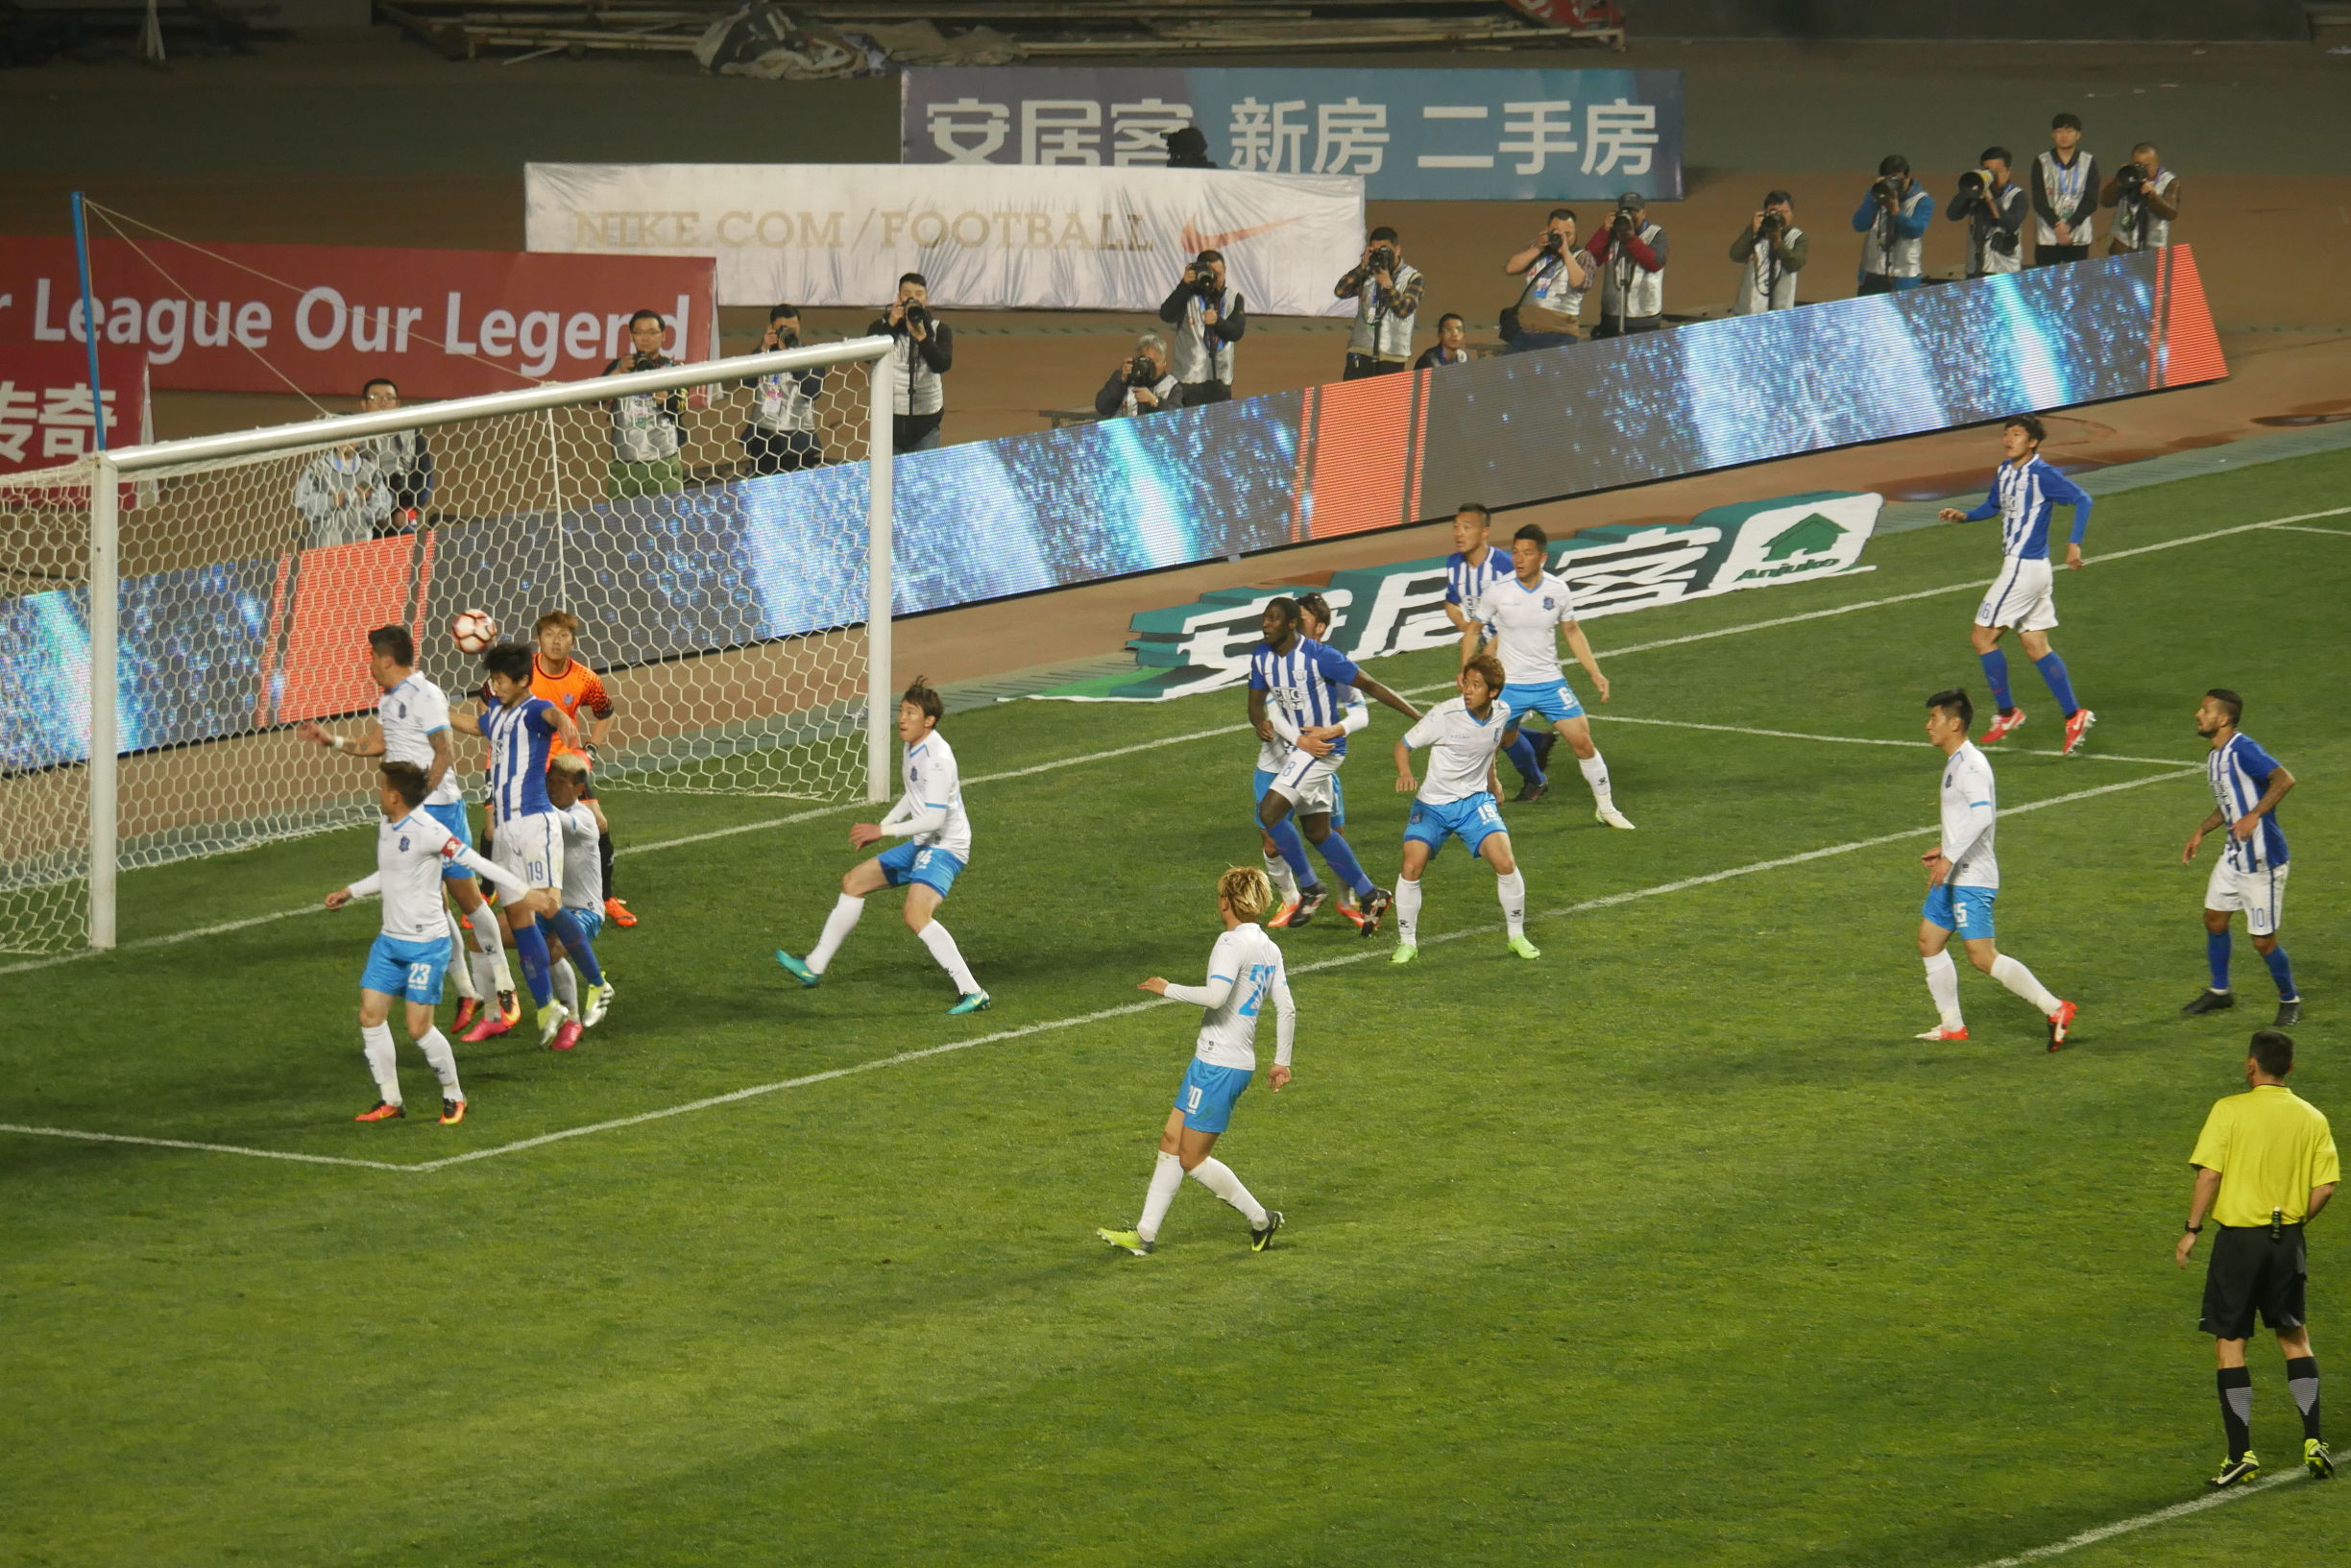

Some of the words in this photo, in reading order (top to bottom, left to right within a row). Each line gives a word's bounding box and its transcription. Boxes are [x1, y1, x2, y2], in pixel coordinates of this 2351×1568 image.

[927, 98, 1194, 167] 安居客
[1228, 97, 1390, 175] 新房
[1418, 98, 1659, 176] 二手房
[34, 277, 273, 365] League
[295, 285, 422, 352] Our
[445, 291, 691, 377] Legend
[1558, 686, 1574, 705] 6
[1282, 760, 1297, 777] 8
[1477, 804, 1500, 822] 19
[527, 859, 545, 882] 19
[2251, 907, 2266, 929] 10
[407, 962, 431, 984] 23
